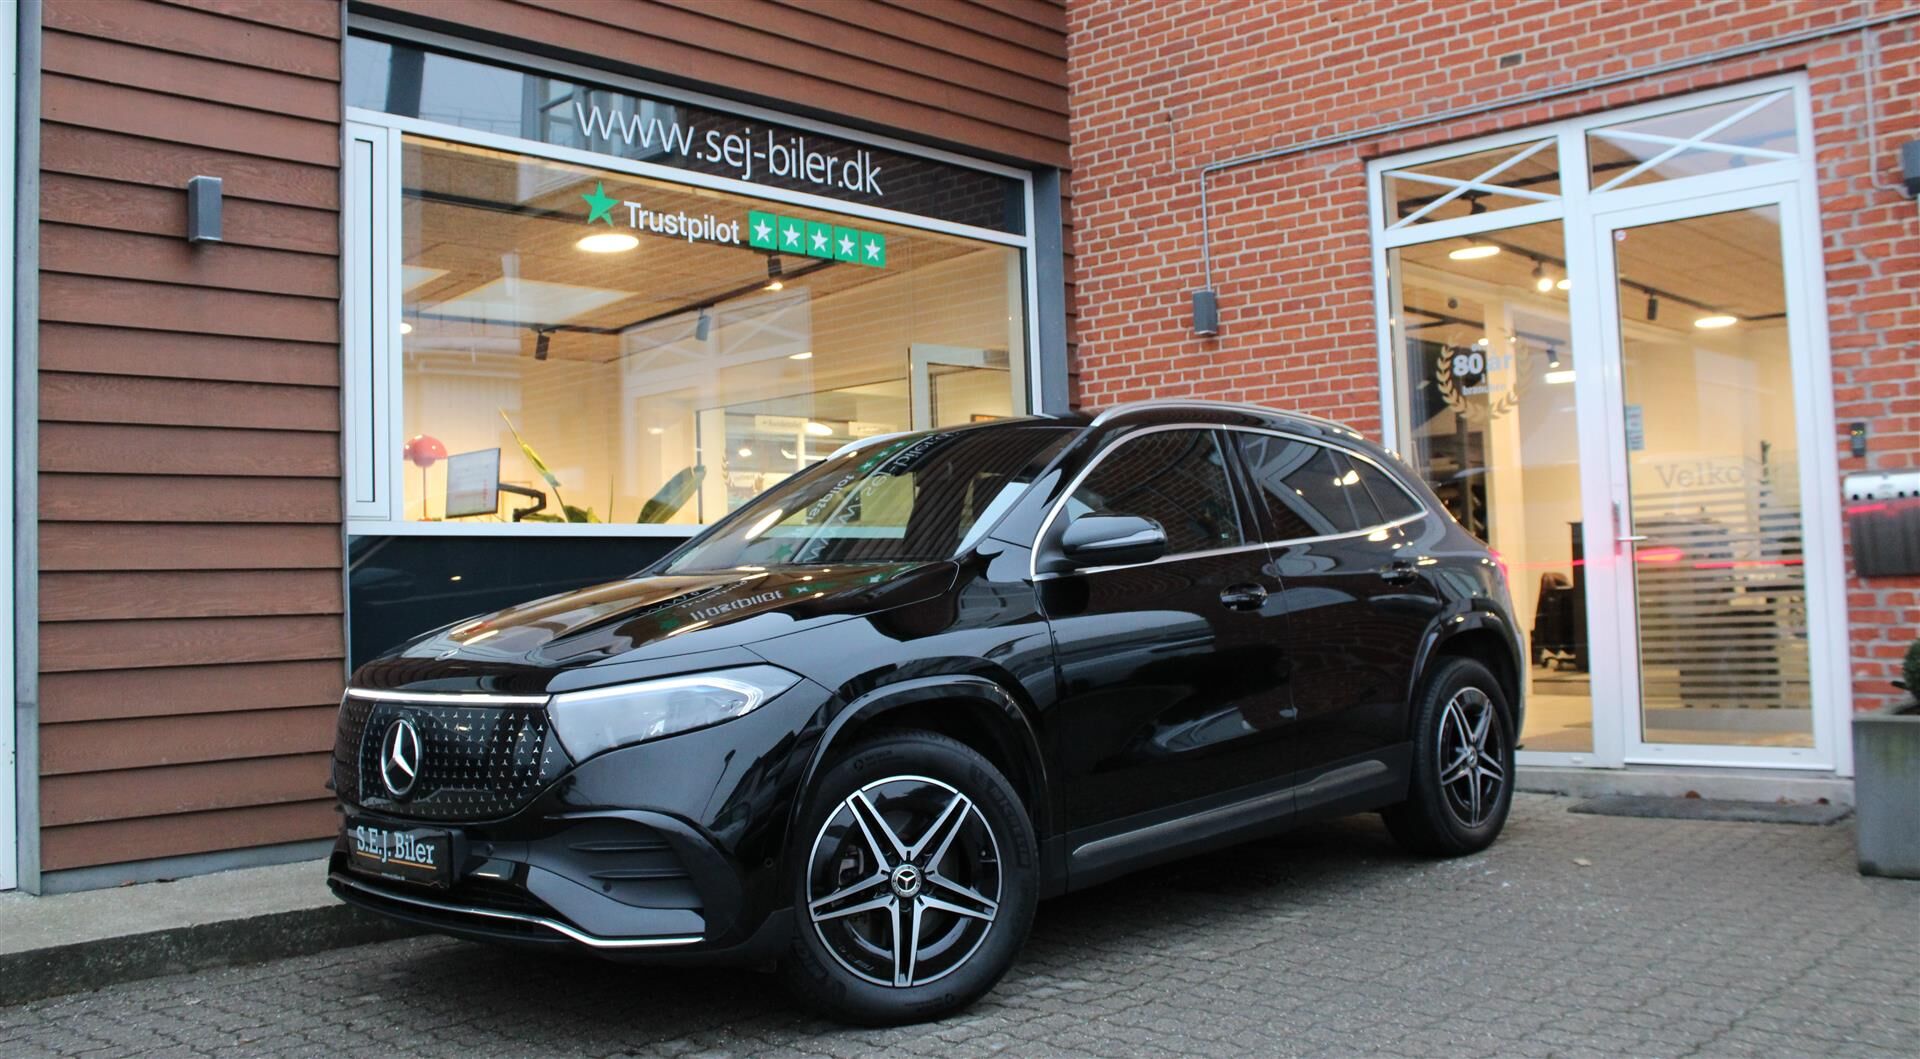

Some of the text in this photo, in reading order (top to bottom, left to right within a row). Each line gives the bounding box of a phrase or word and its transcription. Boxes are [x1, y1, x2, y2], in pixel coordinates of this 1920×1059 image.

[576, 102, 883, 196] www.sej-biler.dk
[624, 201, 740, 245] Trustpilot
[1453, 353, 1484, 377] 80
[356, 825, 435, 864] S.E.J. Biler
